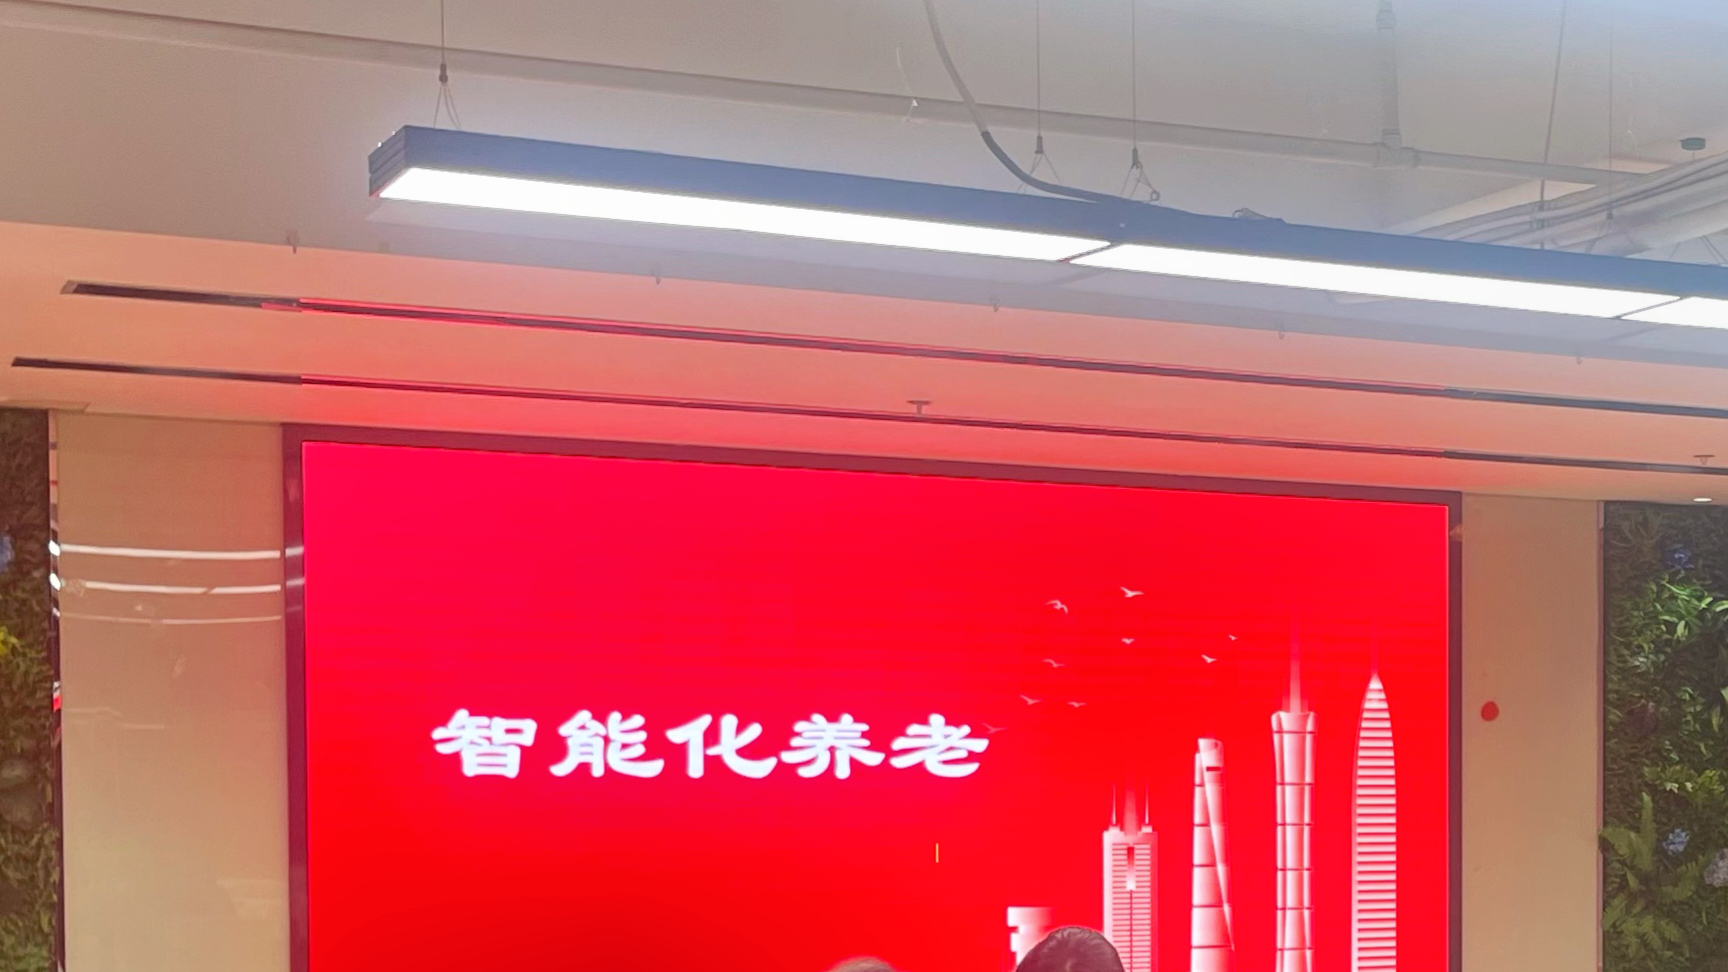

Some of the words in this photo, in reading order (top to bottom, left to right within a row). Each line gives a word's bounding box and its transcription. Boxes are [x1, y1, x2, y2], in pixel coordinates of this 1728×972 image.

[431, 708, 990, 779] 智能化养老
